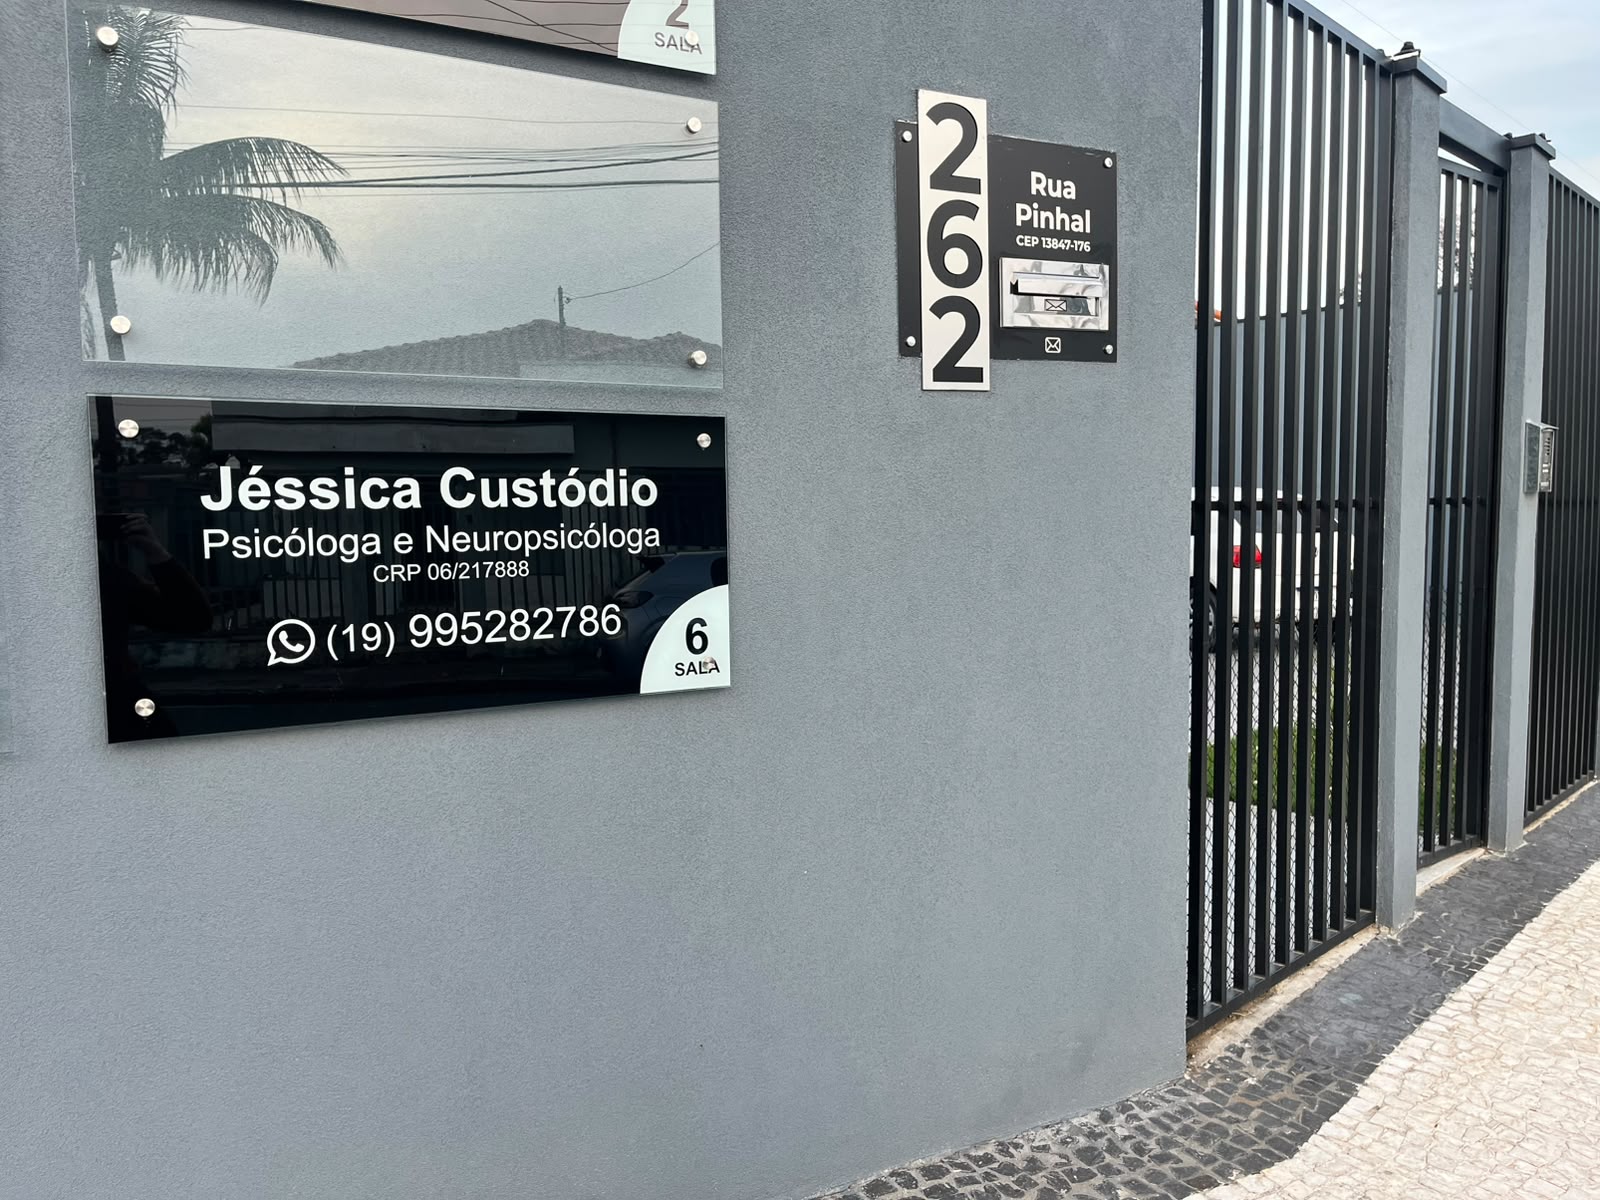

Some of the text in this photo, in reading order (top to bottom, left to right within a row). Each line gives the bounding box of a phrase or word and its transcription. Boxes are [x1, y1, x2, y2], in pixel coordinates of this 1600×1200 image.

[665, 0, 690, 29] 2
[654, 31, 703, 55] SALA
[1030, 171, 1077, 200] Rua
[1015, 202, 1092, 234] Pinhal
[926, 102, 984, 384] 262
[1015, 234, 1092, 253] CEP 13847-176
[200, 465, 658, 511] Jéssica Custódio
[203, 522, 661, 563] Psicóloga e Neuropsicóloga
[373, 560, 530, 583] CRP 06/217888
[327, 603, 622, 661] (19) 995282786
[685, 617, 709, 655] 6
[674, 660, 720, 677] SALA
